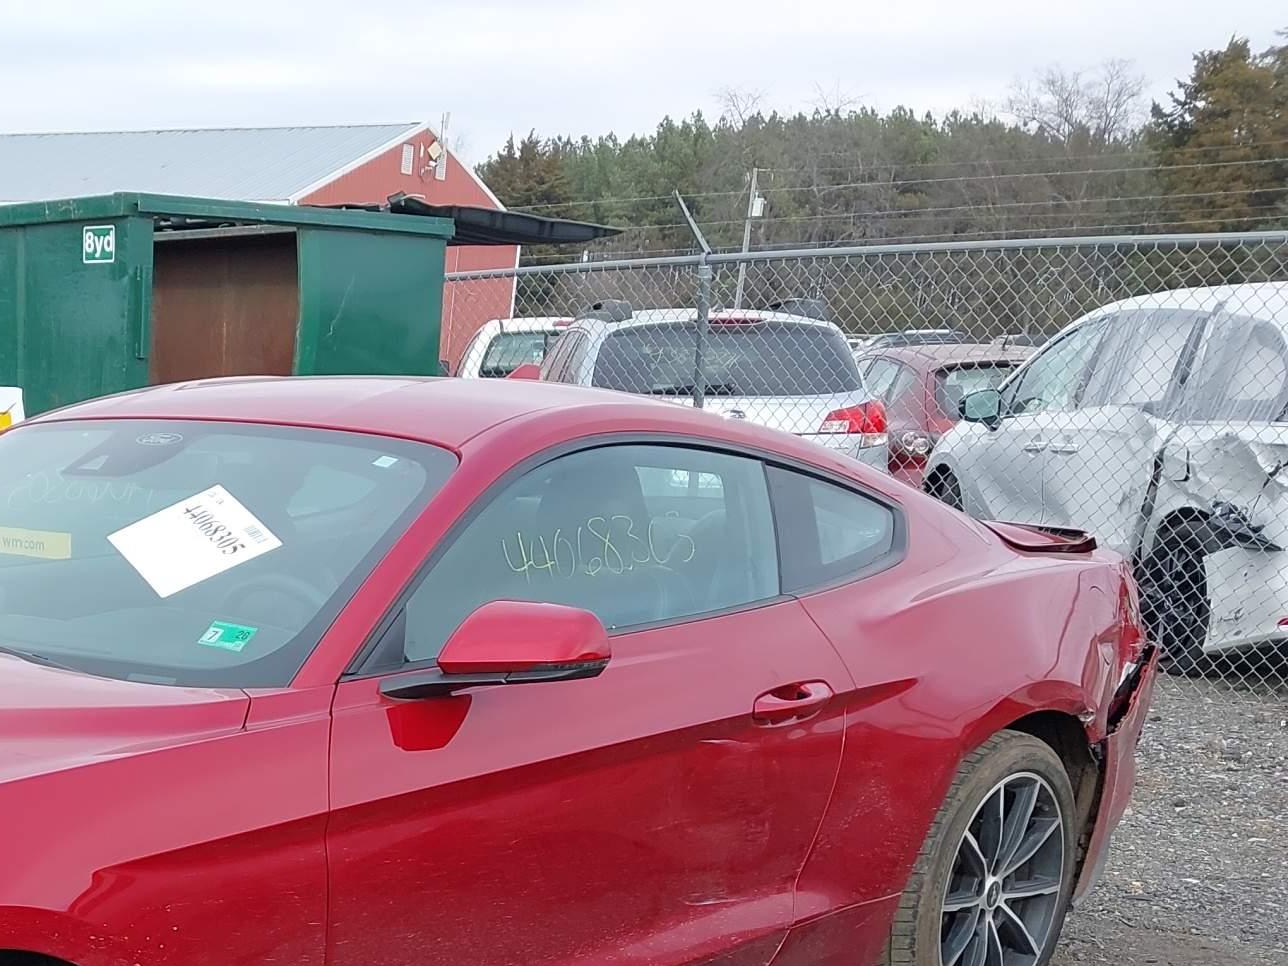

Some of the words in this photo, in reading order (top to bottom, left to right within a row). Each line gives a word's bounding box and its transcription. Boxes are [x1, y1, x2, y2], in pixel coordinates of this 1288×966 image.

[85, 231, 113, 258] 8yd
[183, 505, 246, 555] 44068305
[207, 630, 220, 640] 7
